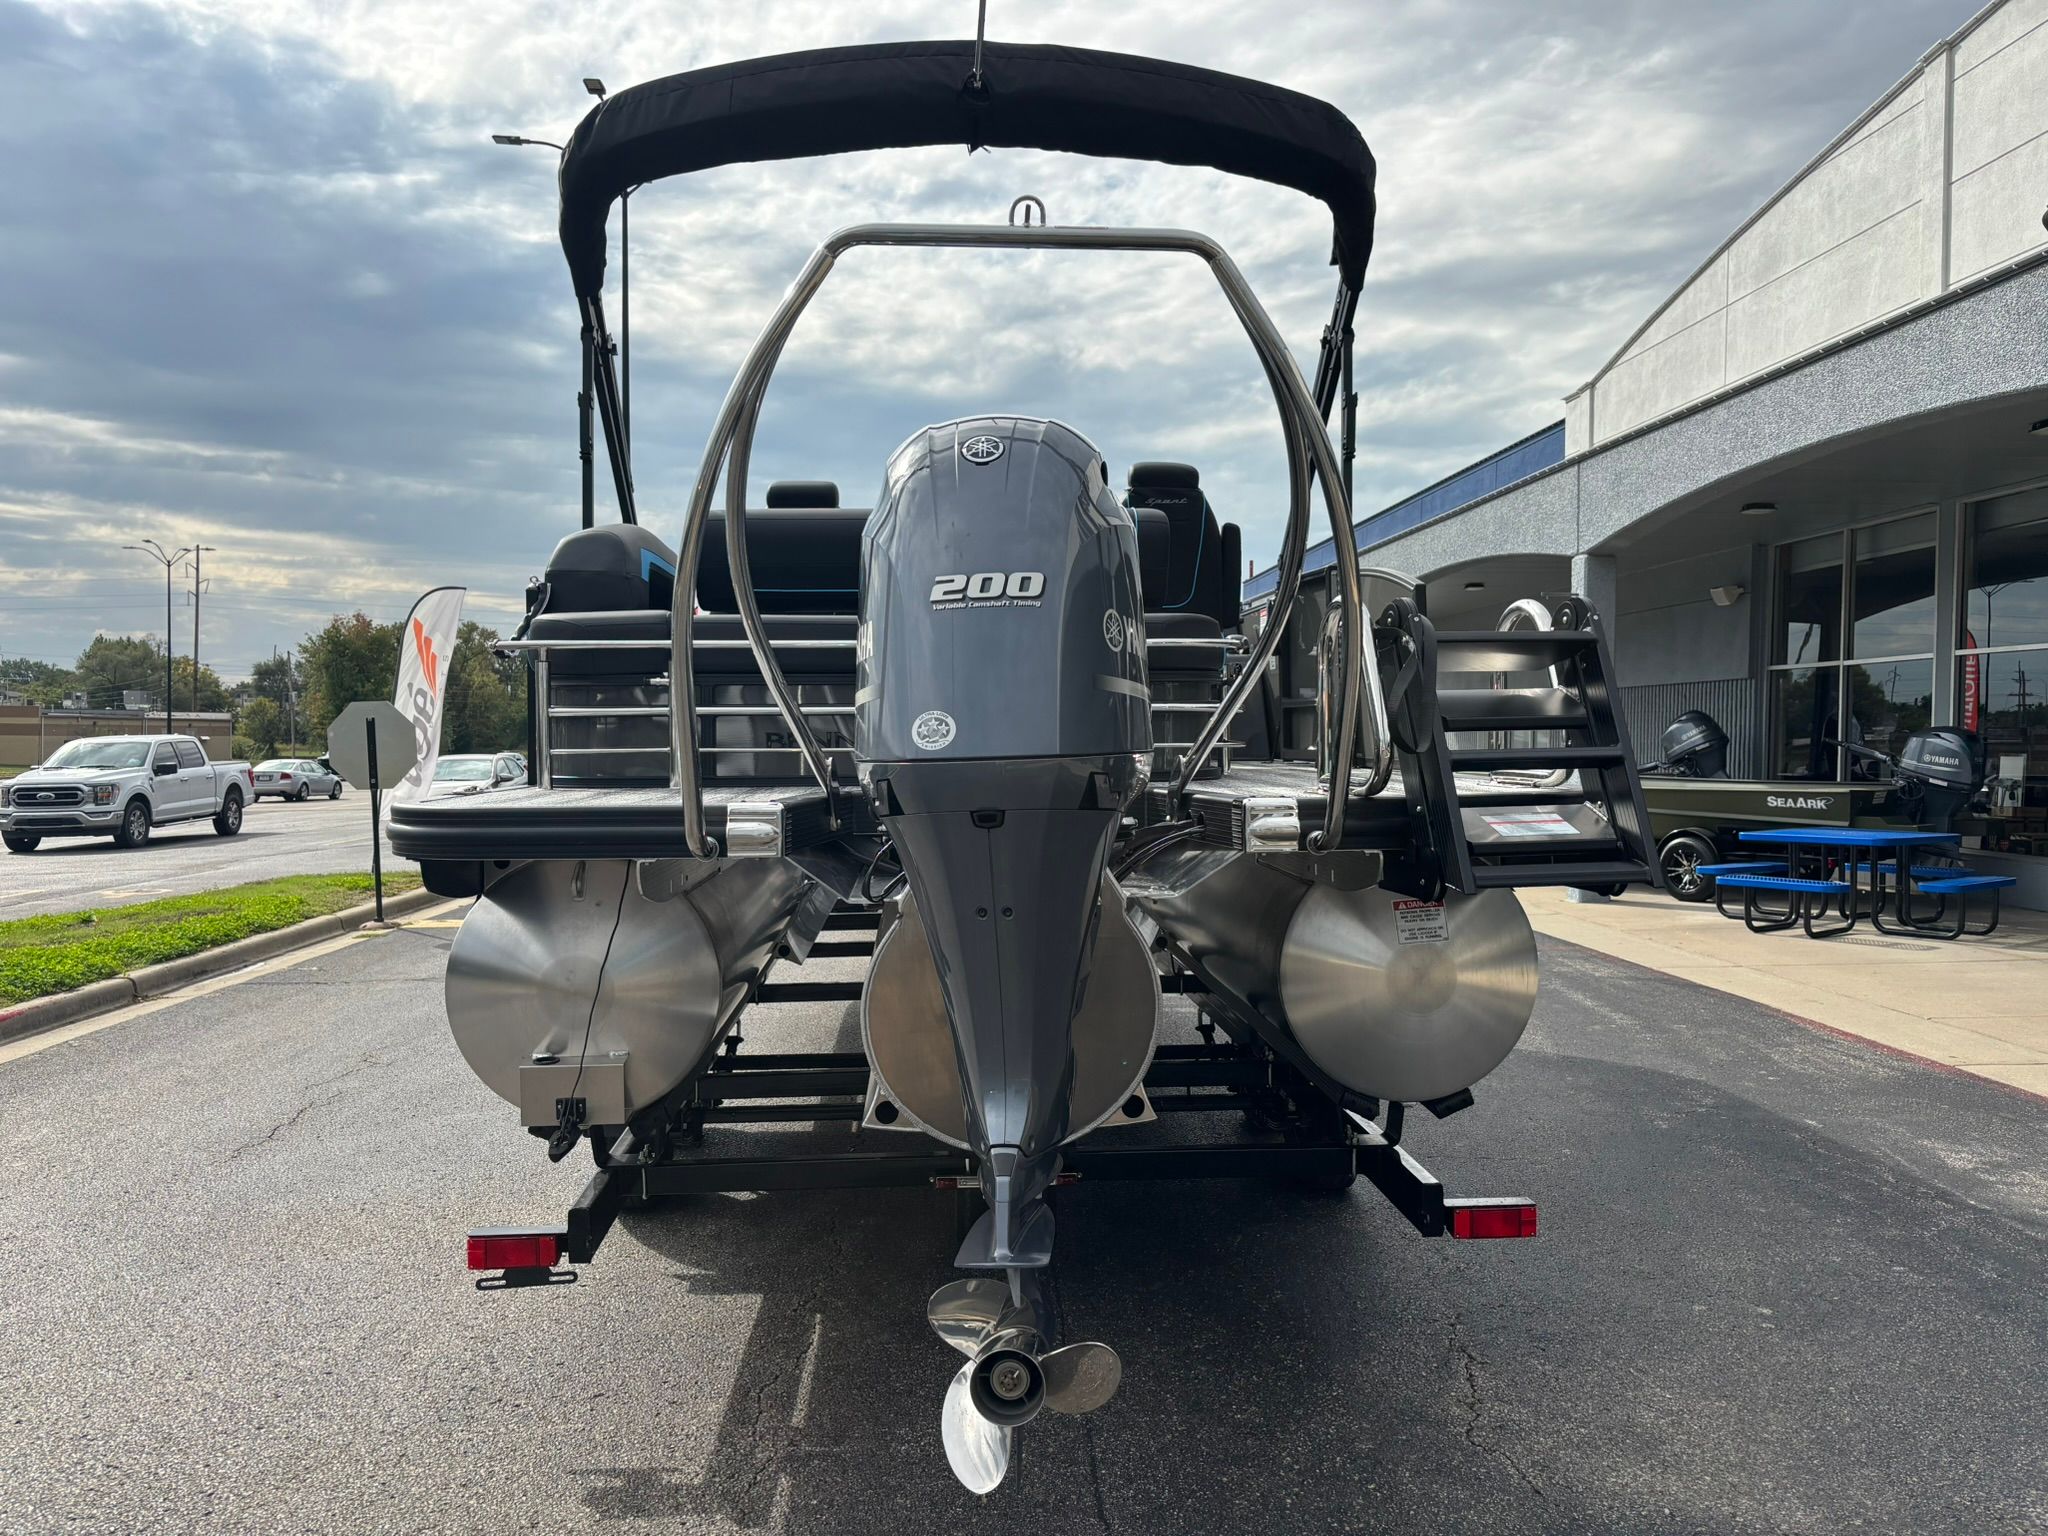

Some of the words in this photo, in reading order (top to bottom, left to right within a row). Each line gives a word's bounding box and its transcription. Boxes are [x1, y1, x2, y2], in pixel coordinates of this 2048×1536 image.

[929, 571, 1047, 602] 200
[932, 601, 967, 611] Variable
[968, 600, 1010, 608] Camshaft
[1012, 599, 1042, 608] Timing
[1931, 755, 1959, 766] YAMAHA
